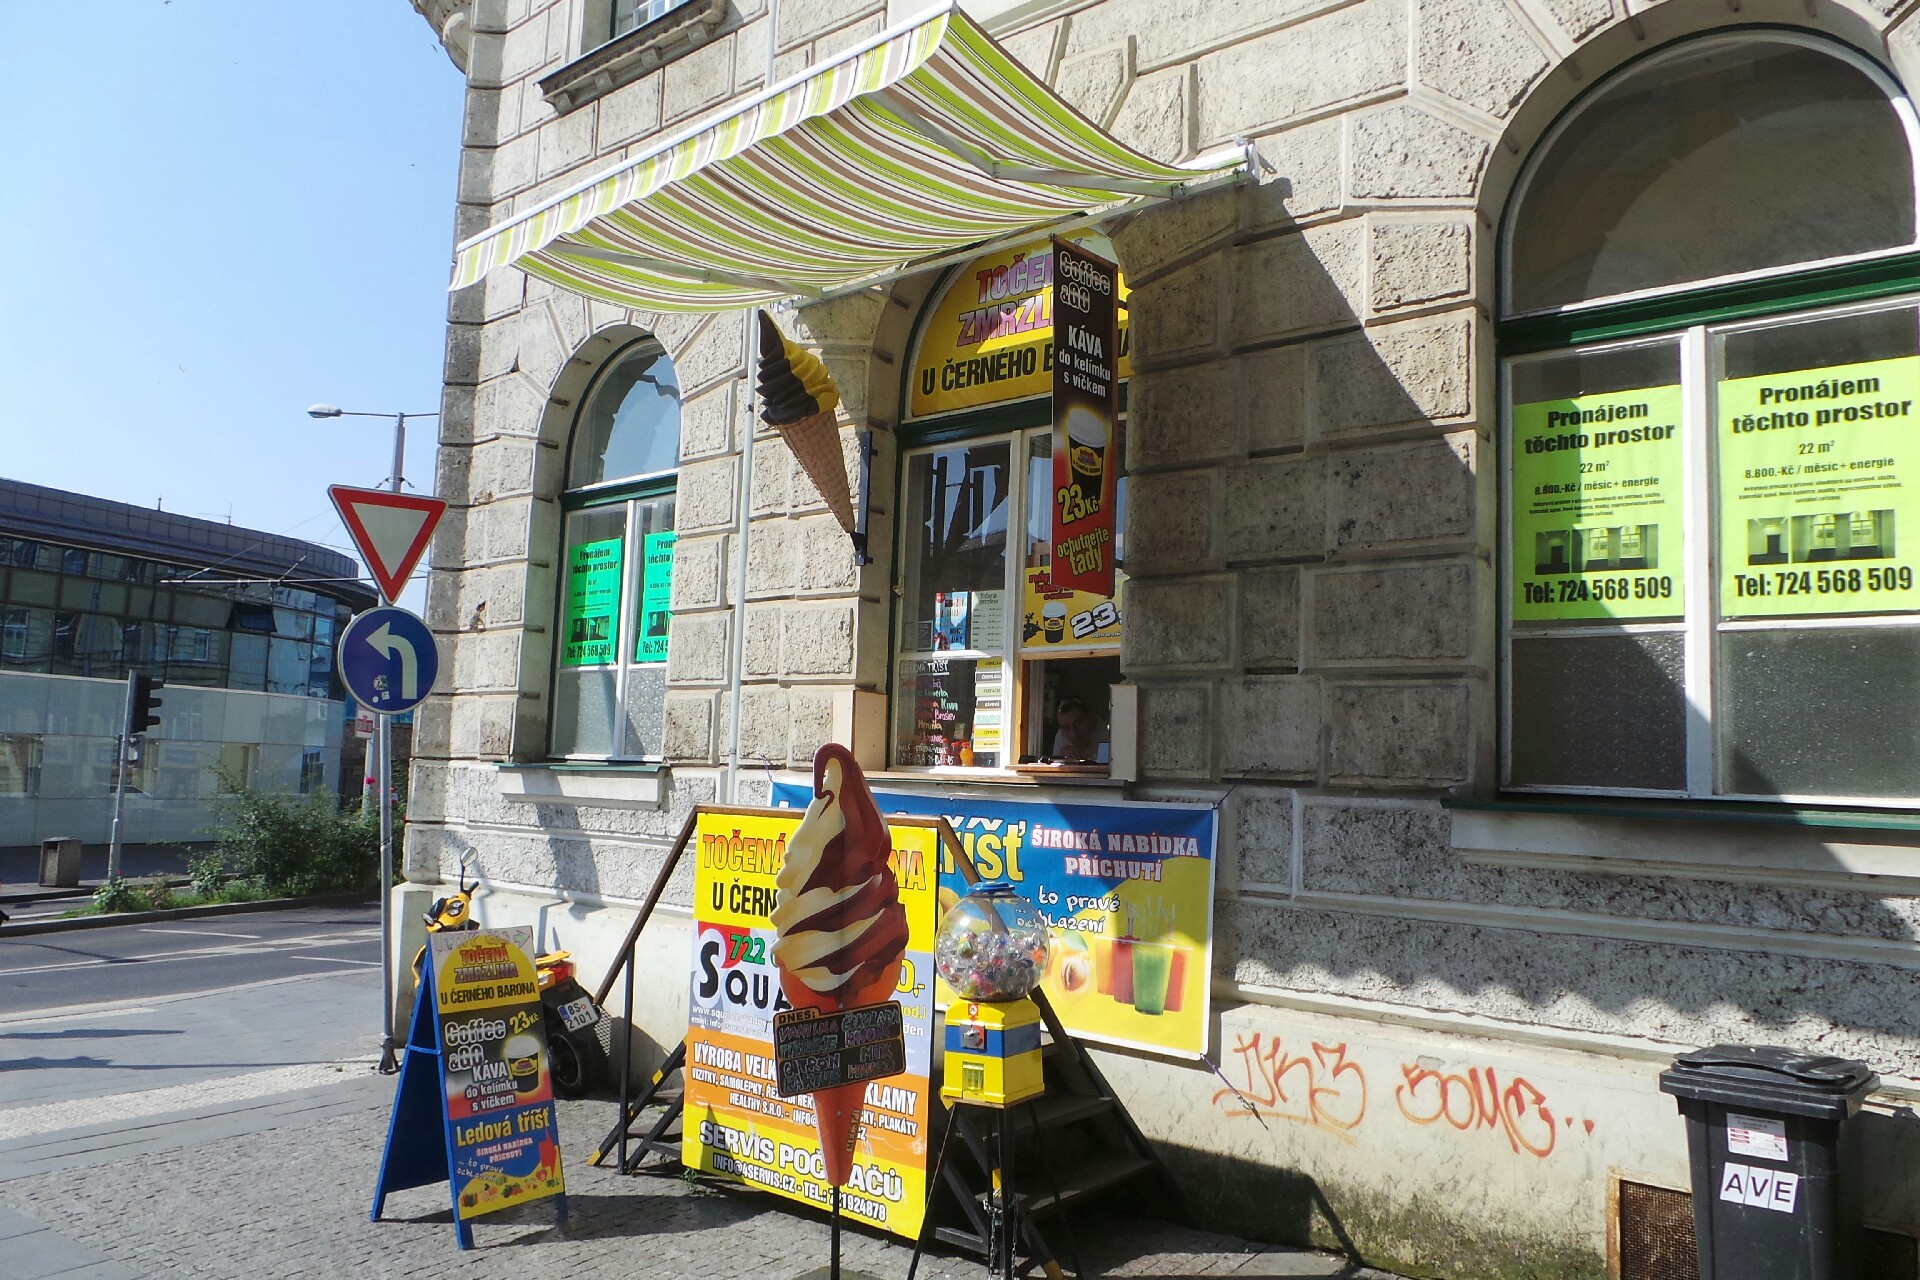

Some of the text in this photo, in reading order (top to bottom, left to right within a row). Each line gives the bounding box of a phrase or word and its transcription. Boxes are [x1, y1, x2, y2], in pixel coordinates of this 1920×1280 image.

[1060, 251, 1110, 296] Coffee
[1068, 325, 1103, 359] KÁVA
[922, 368, 936, 396] U
[941, 347, 1037, 392] ČERNÉHO
[1059, 349, 1070, 365] do
[1074, 354, 1111, 381] kelímku
[1063, 372, 1106, 398] s víčkem
[1760, 377, 1879, 405] Pronájem
[1548, 403, 1649, 428] Pronájem
[1732, 400, 1912, 434] těchto prostor
[1525, 424, 1675, 454] těchto prostor
[1799, 444, 1814, 455] 22
[1580, 463, 1594, 474] 22
[1804, 462, 1839, 474] měsíc
[1850, 457, 1895, 469] energie
[1584, 479, 1612, 491] měsíc
[1622, 476, 1660, 489] energie
[1057, 527, 1109, 558] ochutnejte
[1069, 547, 1104, 576] tady
[1524, 575, 1672, 604] Tel: 724 568 509
[1734, 566, 1913, 597] Tel: 724 568 509
[703, 830, 786, 875] TOČENÁ
[1031, 825, 1102, 851] ŠIROKÁ
[1108, 832, 1199, 857] NABÍDKA
[1065, 855, 1163, 881] PŘÍCHUTÍ
[712, 881, 724, 911] U
[1039, 884, 1120, 912] to pravé
[460, 944, 509, 966] TOČENÁ
[730, 934, 766, 965] 722
[454, 962, 518, 984] ZMRZLINA
[699, 941, 793, 1012] SQUA
[440, 982, 536, 1005] U ČERNÉHO BARONA
[567, 1011, 592, 1029] 2101
[779, 1010, 816, 1024] DNES:
[445, 1018, 506, 1047] Coffee
[472, 1059, 508, 1083] KÁVA
[694, 1041, 777, 1083] VÝROBA VELK
[466, 1079, 518, 1099] do kelímku
[692, 1067, 718, 1087] VIZITKY,
[720, 1074, 765, 1098] SAMOLEPKY,
[472, 1095, 515, 1112] s víčkem
[729, 1092, 761, 1112] HEALTHY
[762, 1101, 784, 1119] S.R.O.
[792, 1108, 818, 1128] INFO@
[456, 1115, 512, 1148] Ledová
[879, 1114, 917, 1137] PLAKÁTY
[699, 1120, 775, 1165] SERVIS
[713, 1153, 795, 1193] INFO@4SERVIS.CZ
[1724, 1173, 1793, 1203] AVE
